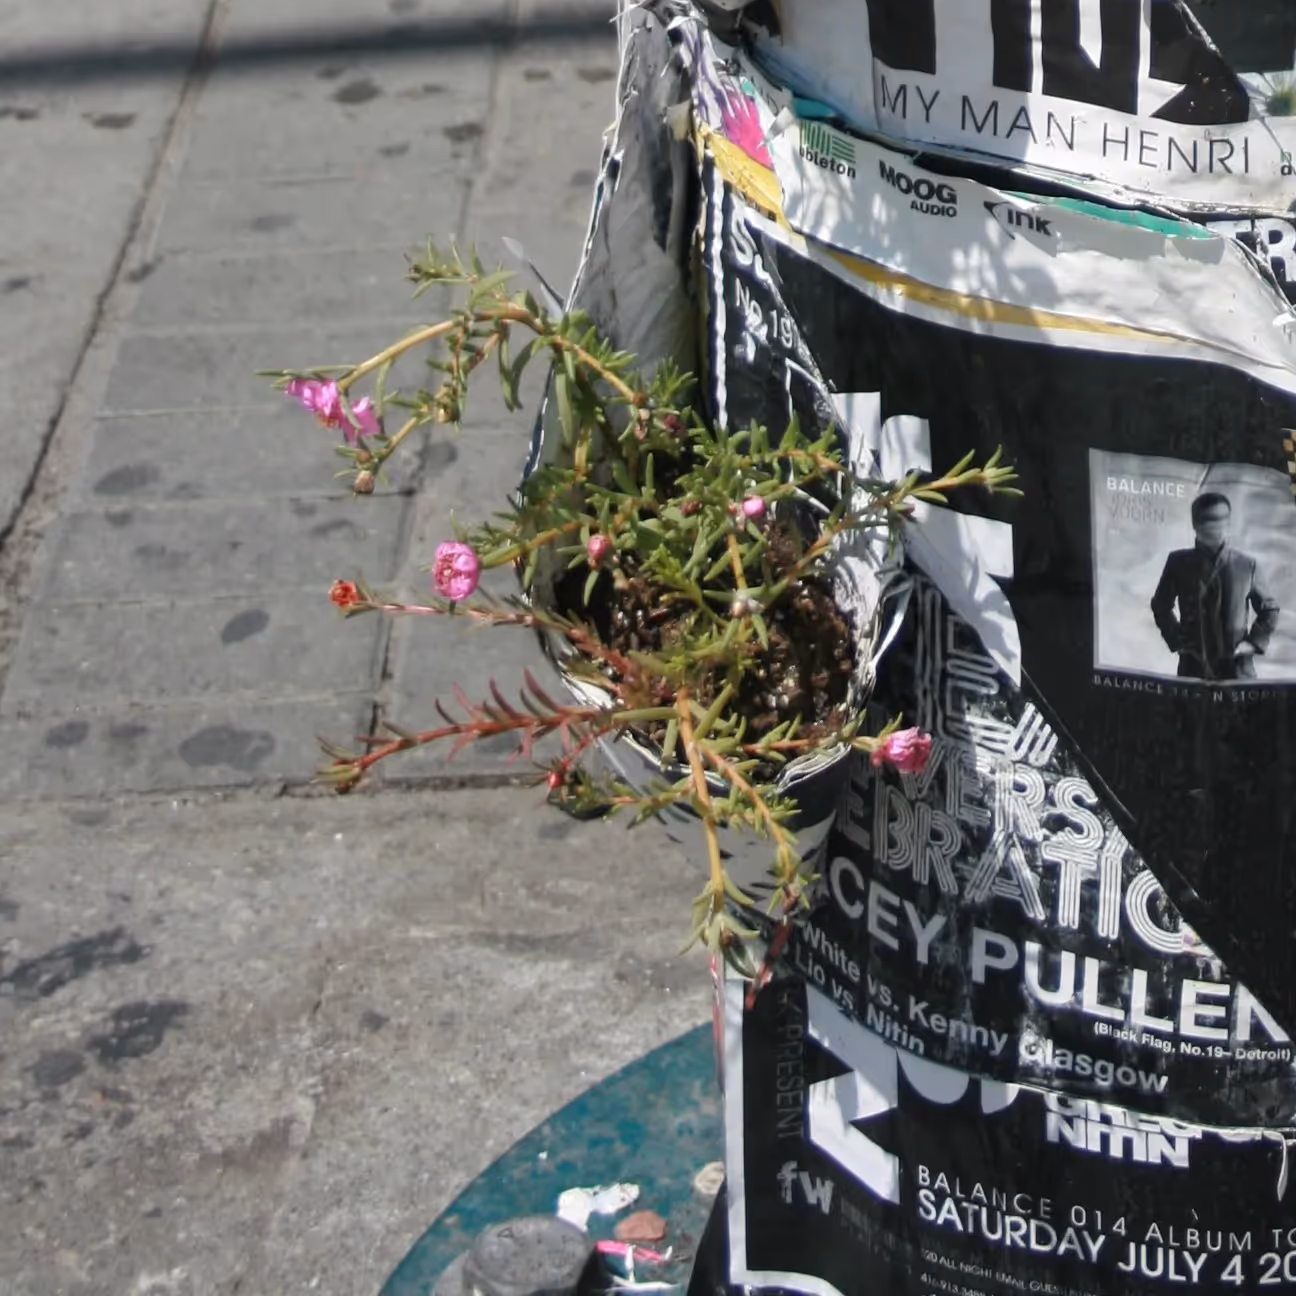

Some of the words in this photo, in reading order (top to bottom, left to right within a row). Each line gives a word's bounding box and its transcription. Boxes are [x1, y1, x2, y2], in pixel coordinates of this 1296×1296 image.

[878, 73, 942, 126] MY
[960, 93, 1076, 152] MAN
[1101, 121, 1252, 176] HENRI
[877, 158, 959, 206] MOOG
[908, 198, 959, 219] AUDIO
[1106, 476, 1186, 497] BALANCE
[1093, 674, 1165, 696] BALANCE
[865, 1006, 926, 1057] Nitin
[908, 997, 1009, 1059] Kenny
[1016, 1035, 1170, 1095] Glasgow
[1093, 1019, 1138, 1043] (Black
[1141, 1029, 1177, 1055] Flag,
[1234, 1045, 1292, 1065] Detroit)
[918, 1164, 1053, 1220] BALANCE
[1071, 1204, 1128, 1238] 014
[1144, 1221, 1253, 1252] ALBUM
[918, 1186, 1106, 1265] SATURDAY
[1117, 1241, 1208, 1284] JULY
[1220, 1254, 1246, 1286] 4
